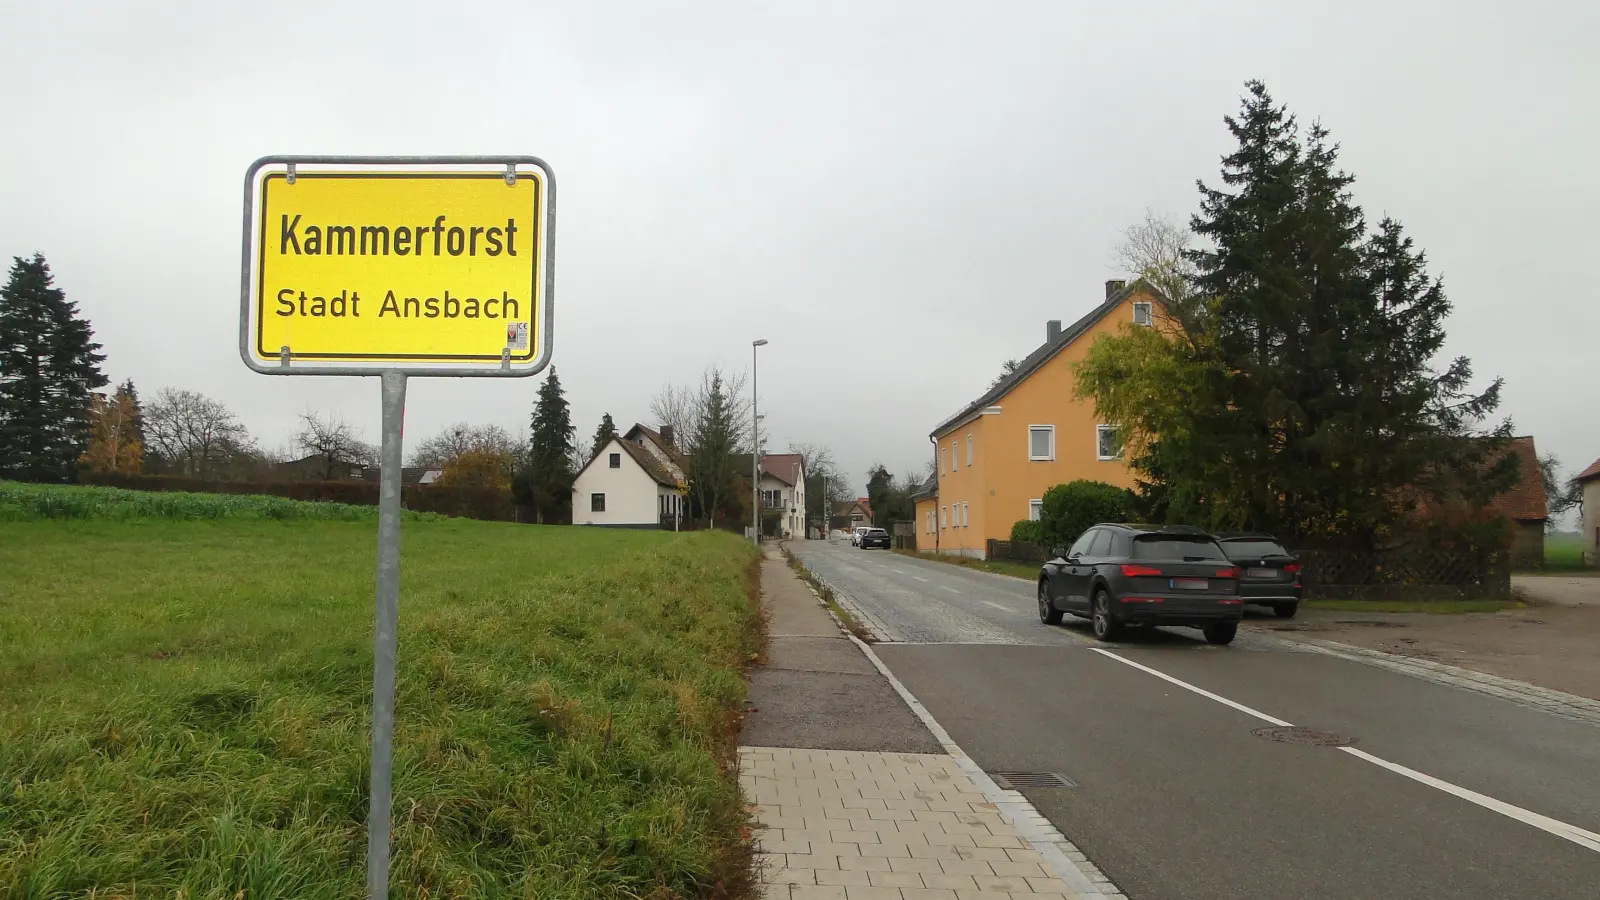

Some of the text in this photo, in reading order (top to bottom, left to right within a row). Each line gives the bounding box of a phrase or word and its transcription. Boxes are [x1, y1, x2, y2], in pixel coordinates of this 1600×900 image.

[280, 215, 518, 257] Kammerforst
[276, 288, 519, 319] Stadt Ansbach
